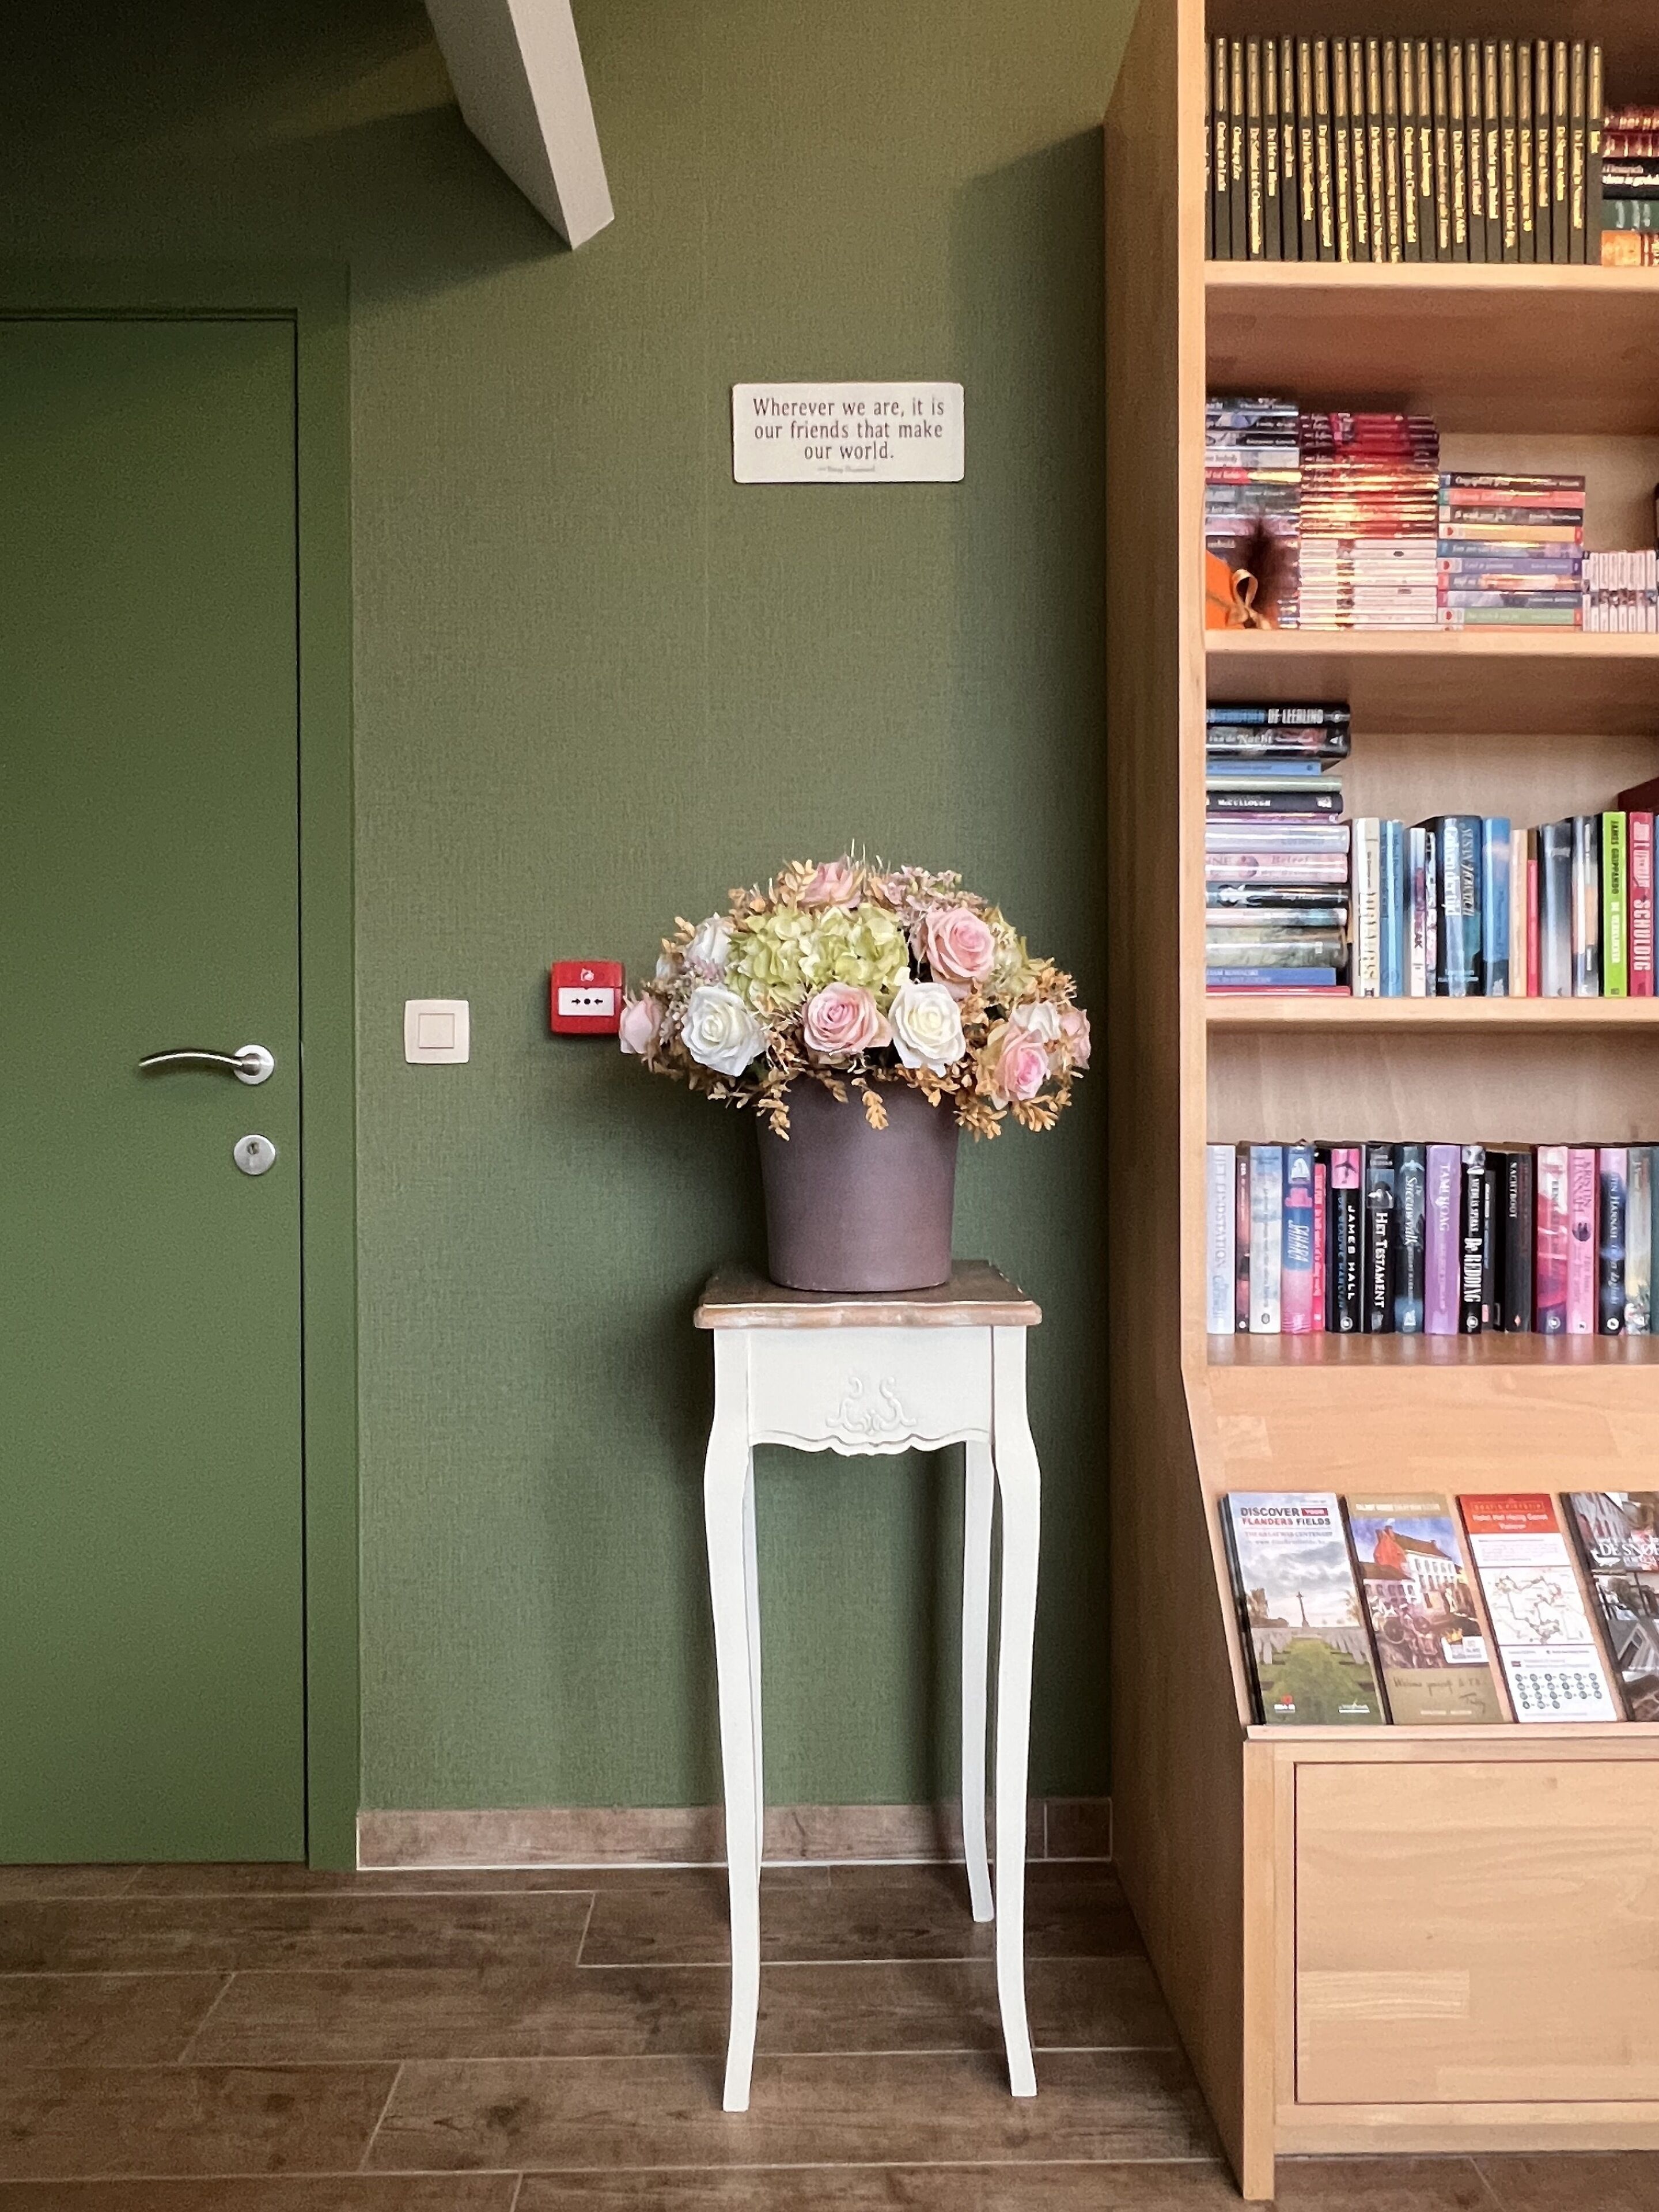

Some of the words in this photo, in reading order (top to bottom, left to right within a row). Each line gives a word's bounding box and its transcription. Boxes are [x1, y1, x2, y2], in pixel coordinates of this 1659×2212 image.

[753, 397, 835, 416] Wherever
[843, 402, 865, 416] we
[873, 402, 904, 418] are,
[912, 398, 923, 415] it
[931, 397, 944, 415] is
[755, 424, 783, 439] our
[790, 419, 849, 439] friends
[857, 419, 889, 438] that
[899, 419, 942, 438] make
[804, 445, 832, 460] our
[839, 441, 894, 460] world.
[1237, 733, 1273, 744] Nacht
[1633, 899, 1650, 971] SCHULDIG
[1509, 1161, 1517, 1218] NACHTBOOT
[1584, 1161, 1592, 1208] KRISTIN
[1347, 1205, 1355, 1255] JAMES
[1376, 1212, 1388, 1235] HET
[1404, 1175, 1418, 1247] Sneeuwvalk
[1609, 1196, 1619, 1238] HANNAH
[1287, 1219, 1309, 1263] SAHARA
[1347, 1262, 1355, 1301] HALL
[1374, 1239, 1387, 1308] TESTAMENT
[1464, 1254, 1482, 1302] REDDING
[1240, 1507, 1300, 1516] DISCOVER
